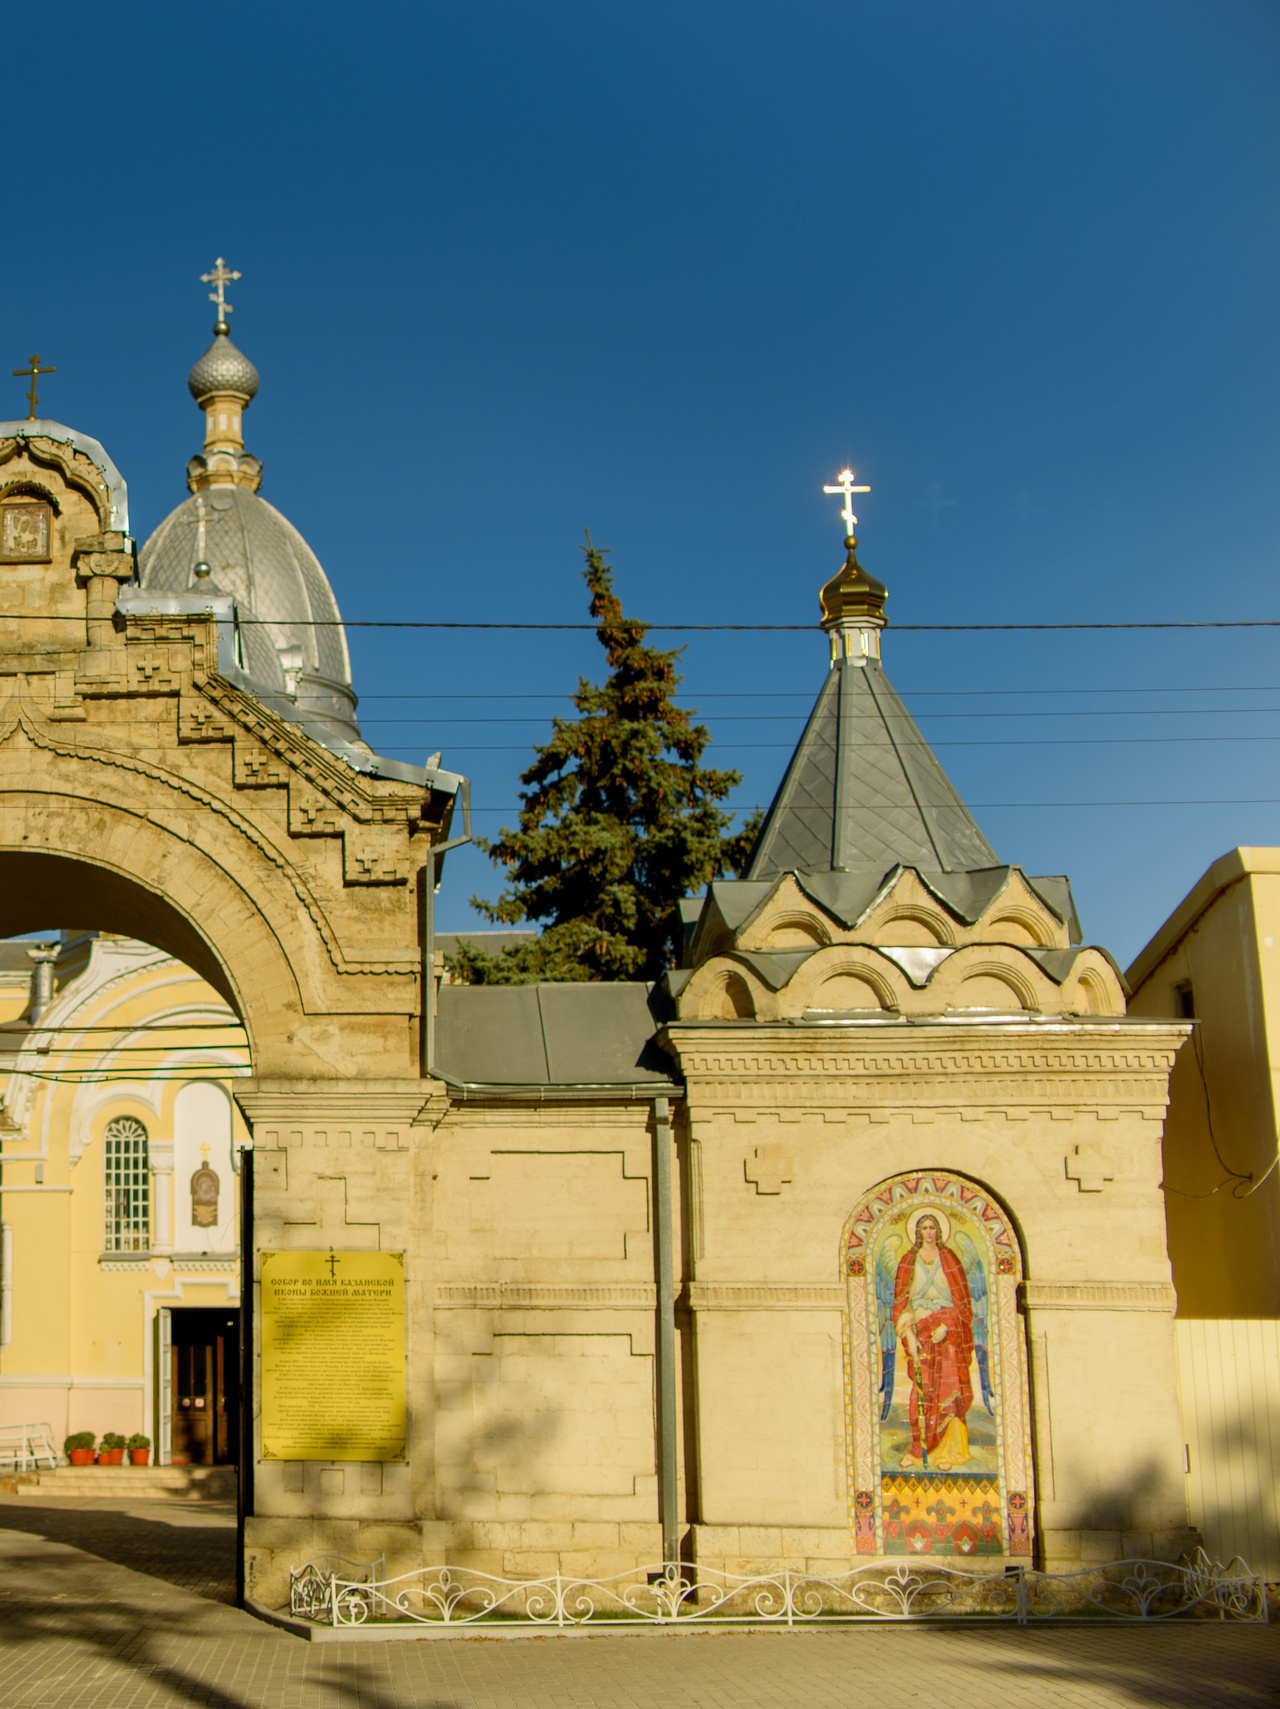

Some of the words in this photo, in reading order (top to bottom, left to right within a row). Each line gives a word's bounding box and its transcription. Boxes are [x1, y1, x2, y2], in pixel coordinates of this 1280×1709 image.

[271, 1279, 299, 1287] СОБОР
[301, 1279, 313, 1287] ВО
[315, 1279, 338, 1287] ИМЯ
[340, 1279, 395, 1287] КАЗАНСКОЙ
[274, 1289, 307, 1297] ИКОНЫ
[310, 1289, 349, 1297] БОЖИЕЙ
[351, 1289, 392, 1297] МАТЕРИ
